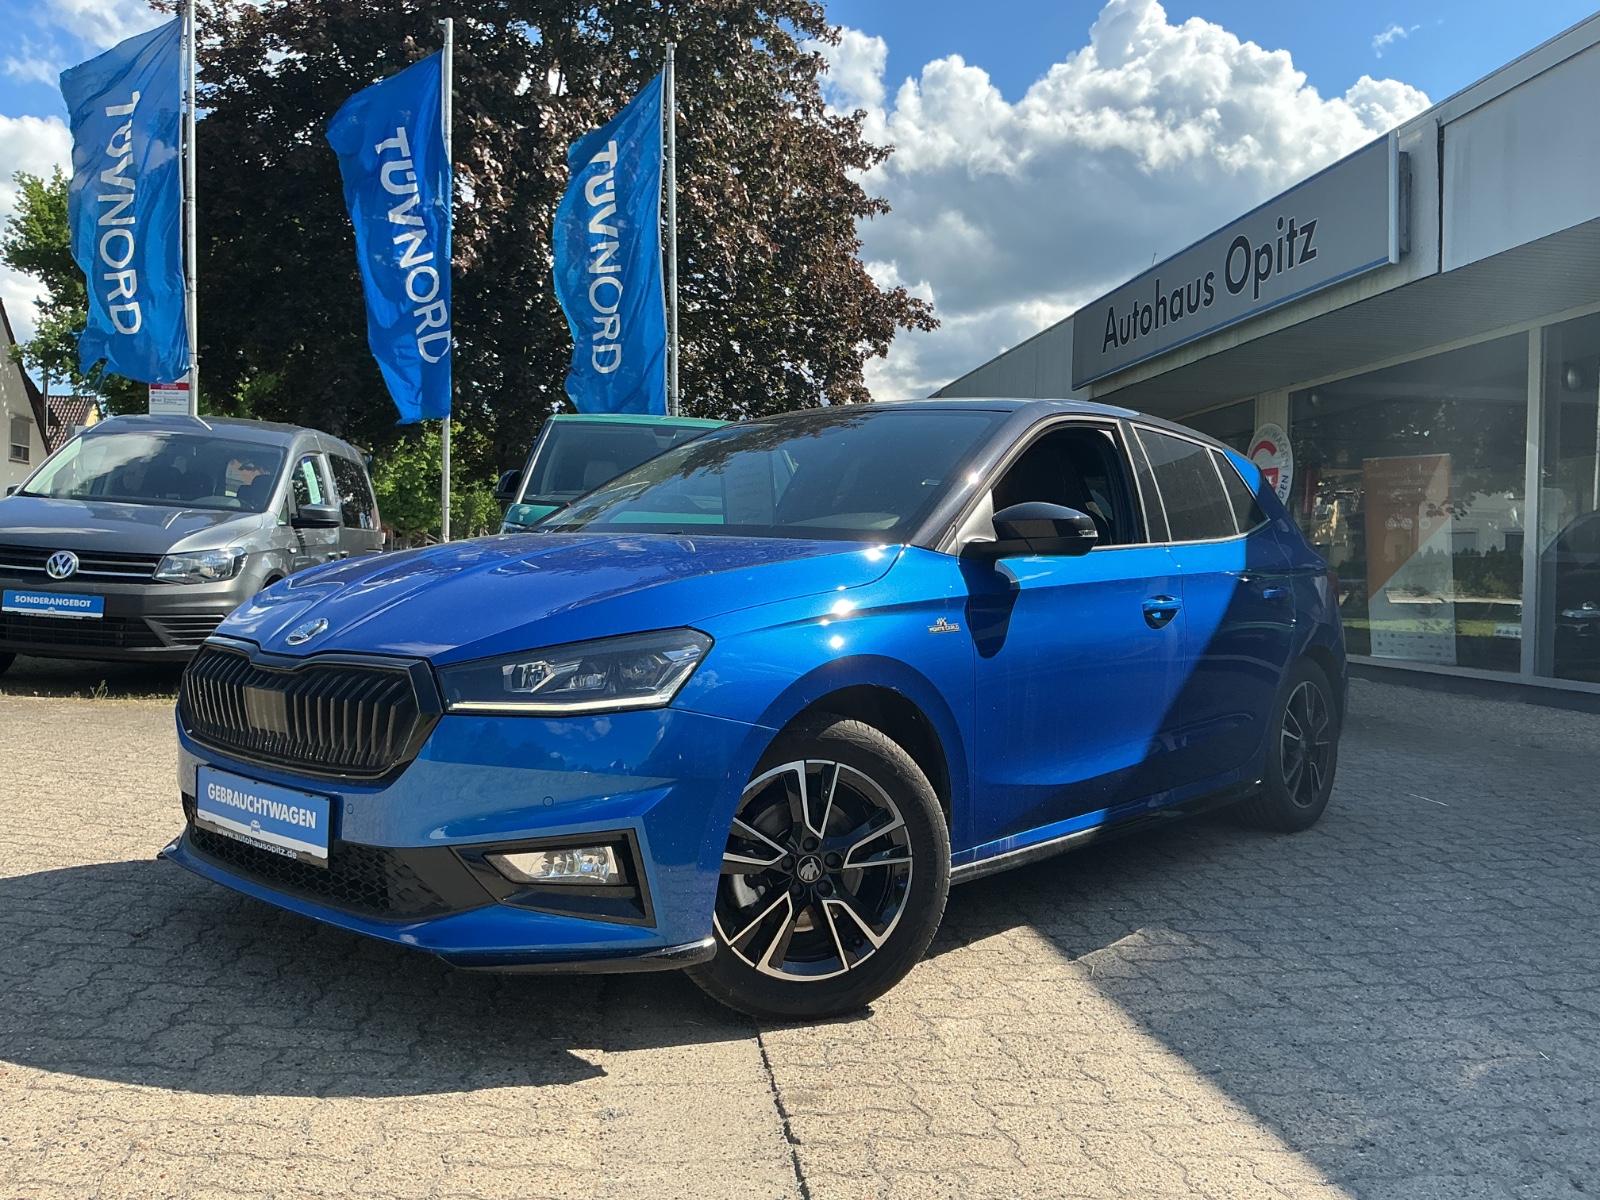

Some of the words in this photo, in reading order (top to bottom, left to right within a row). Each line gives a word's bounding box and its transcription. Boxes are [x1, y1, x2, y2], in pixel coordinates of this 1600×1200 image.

[1101, 270, 1216, 353] Autohaus
[1224, 216, 1318, 300] Opitz
[14, 595, 92, 608] SONDERANGEBOT
[207, 783, 317, 829] GEBRAUCHTWAGEN
[216, 827, 298, 860] www.autohausopitz.de
